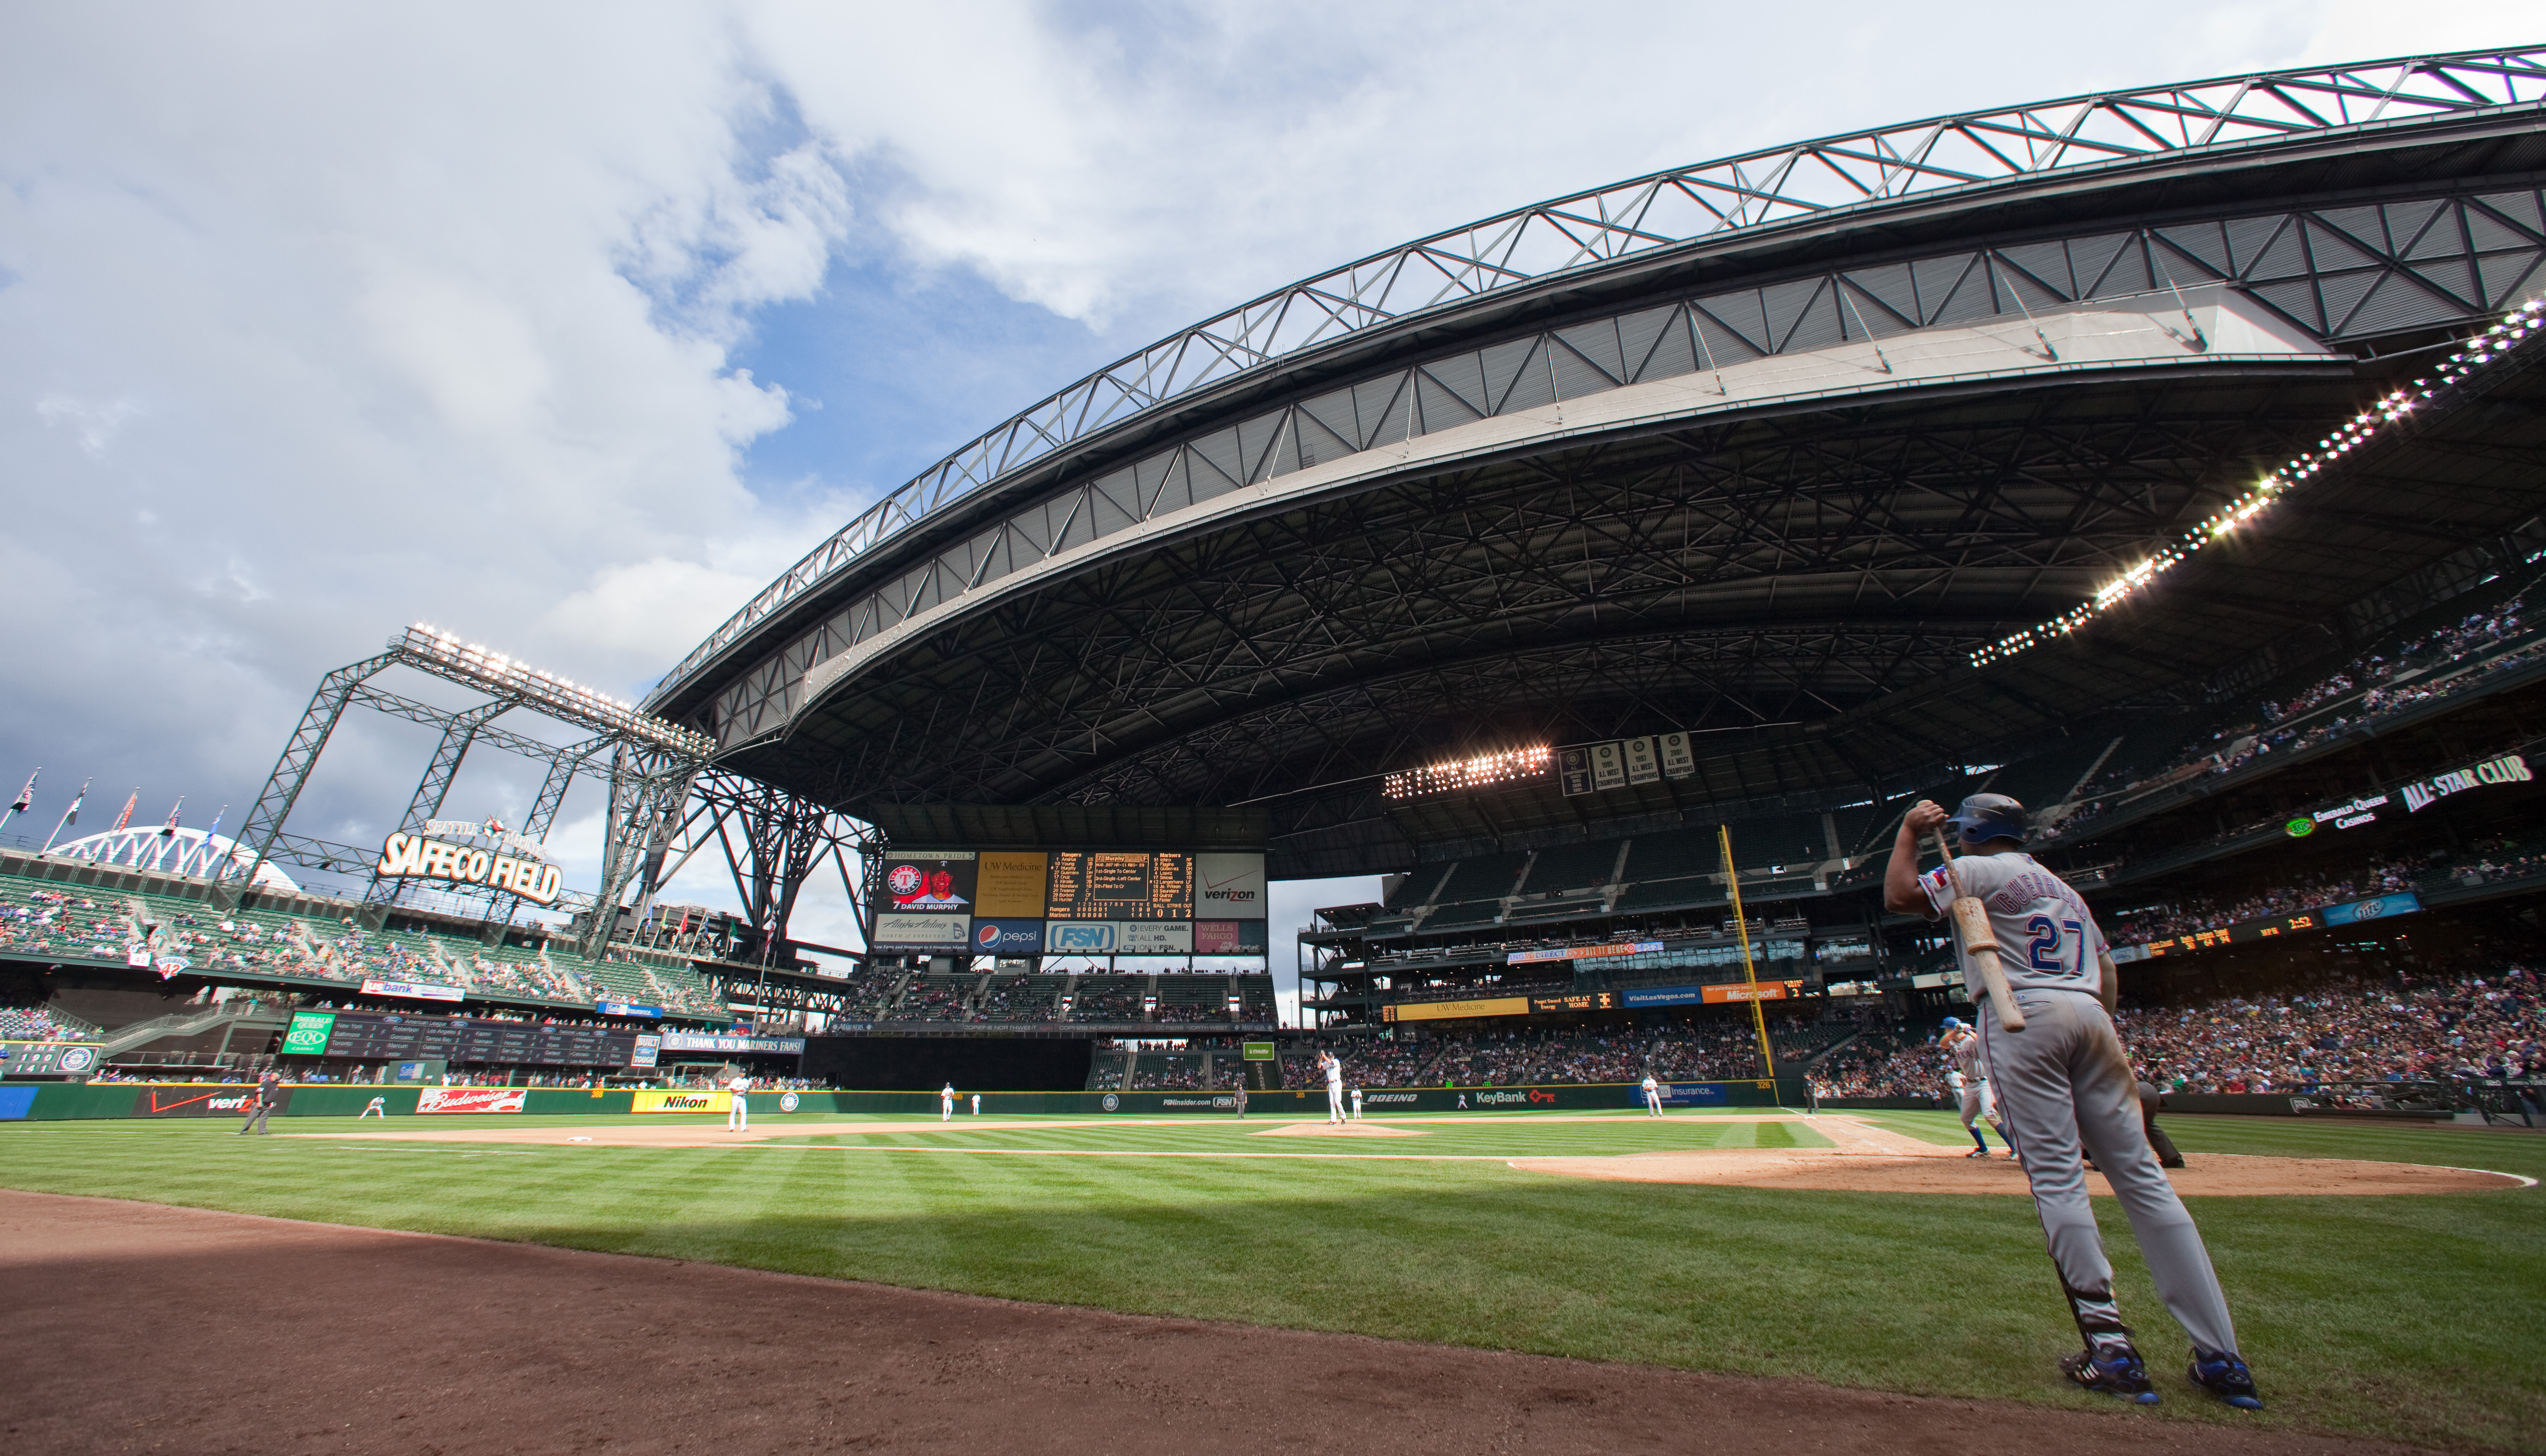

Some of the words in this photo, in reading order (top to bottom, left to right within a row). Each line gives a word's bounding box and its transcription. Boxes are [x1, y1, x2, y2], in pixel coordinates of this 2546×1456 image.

[1631, 771, 1658, 782] CHAMPIONS
[1666, 765, 1693, 776] CHAMPIONS
[1597, 777, 1624, 788] CHAMPIONS
[2401, 782, 2436, 812] ALL
[2433, 768, 2482, 796] STAR
[2476, 755, 2534, 784] CLUB
[2313, 805, 2355, 823] EMERALD
[2354, 794, 2389, 811] QUEEN
[423, 818, 480, 835] SEATTLE
[2335, 812, 2376, 829] CASINOS
[502, 828, 548, 860] MARINERS
[377, 832, 490, 882] SAFECO
[488, 854, 563, 904] FIELD
[894, 867, 919, 877] TEXAS
[985, 862, 1002, 870] UW
[1003, 862, 1042, 871] Medicine
[900, 875, 911, 885] T
[890, 881, 920, 893] RANGERS
[1205, 888, 1255, 901] verizon
[1993, 871, 2087, 921] GUERRERO
[893, 901, 900, 909] 7
[1157, 909, 1163, 918] 0
[1172, 909, 1177, 918] 1
[1185, 909, 1191, 918] 2
[883, 919, 914, 929] Alaska
[914, 919, 947, 929] Airlines
[2288, 916, 2313, 929] 2:52
[1003, 931, 1037, 943] pepsi
[1060, 928, 1105, 947] FSN
[1599, 946, 1605, 955] IT
[2025, 914, 2085, 976] 27
[1535, 949, 1566, 959] DIRECT
[161, 964, 180, 977] 42
[1629, 992, 1695, 1002] VisitLasVegas.com
[1727, 988, 1777, 1000] Microsoft
[1792, 988, 1799, 997] 2
[609, 1005, 627, 1014] Safeco
[1436, 1003, 1452, 1012] UW
[1452, 1002, 1485, 1012] Medicine
[292, 1032, 324, 1044] EQC
[637, 1037, 658, 1047] BUILT
[687, 1037, 715, 1049] THANK
[718, 1038, 735, 1050] YOU
[737, 1039, 778, 1051] MARINERS
[779, 1041, 801, 1052] FANS!
[31, 1053, 41, 1062] 9
[633, 1055, 655, 1064] TOUGH
[1672, 1086, 1710, 1095] Insurance
[208, 1095, 254, 1112] veriz
[425, 1090, 511, 1110] Budweiser
[663, 1096, 708, 1109] Nikon
[1216, 1098, 1233, 1106] FSN
[1476, 1091, 1526, 1105] KeyBank
